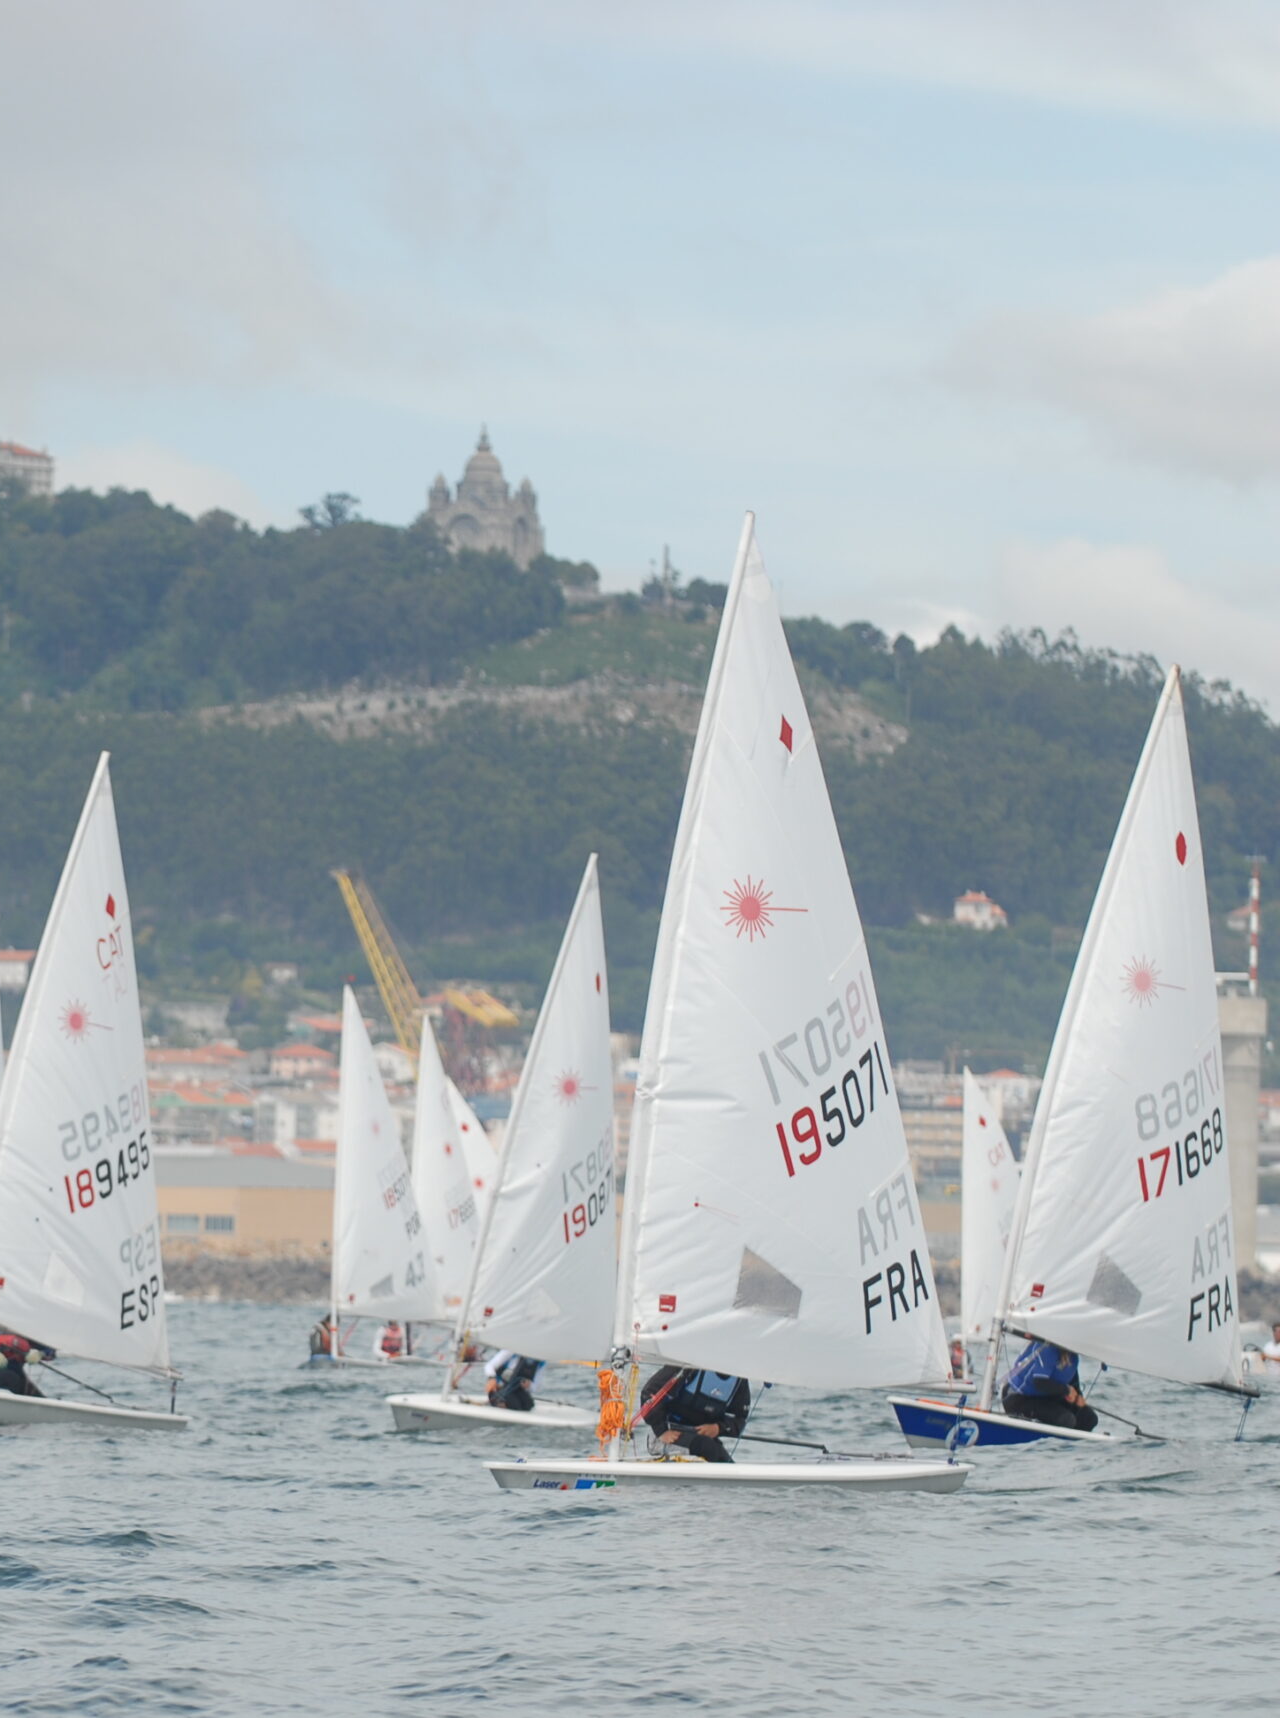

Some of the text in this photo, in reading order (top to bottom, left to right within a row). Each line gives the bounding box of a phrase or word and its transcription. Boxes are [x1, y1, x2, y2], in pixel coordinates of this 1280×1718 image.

[97, 924, 124, 970] CAT
[775, 1041, 889, 1178] 195071
[65, 1130, 150, 1213] 189495
[1138, 1107, 1224, 1202] 171668
[563, 1163, 615, 1244] 190871
[120, 1275, 160, 1330] ESP
[862, 1250, 929, 1335] FRA
[1188, 1276, 1233, 1341] FRA
[533, 1479, 561, 1489] Laser
